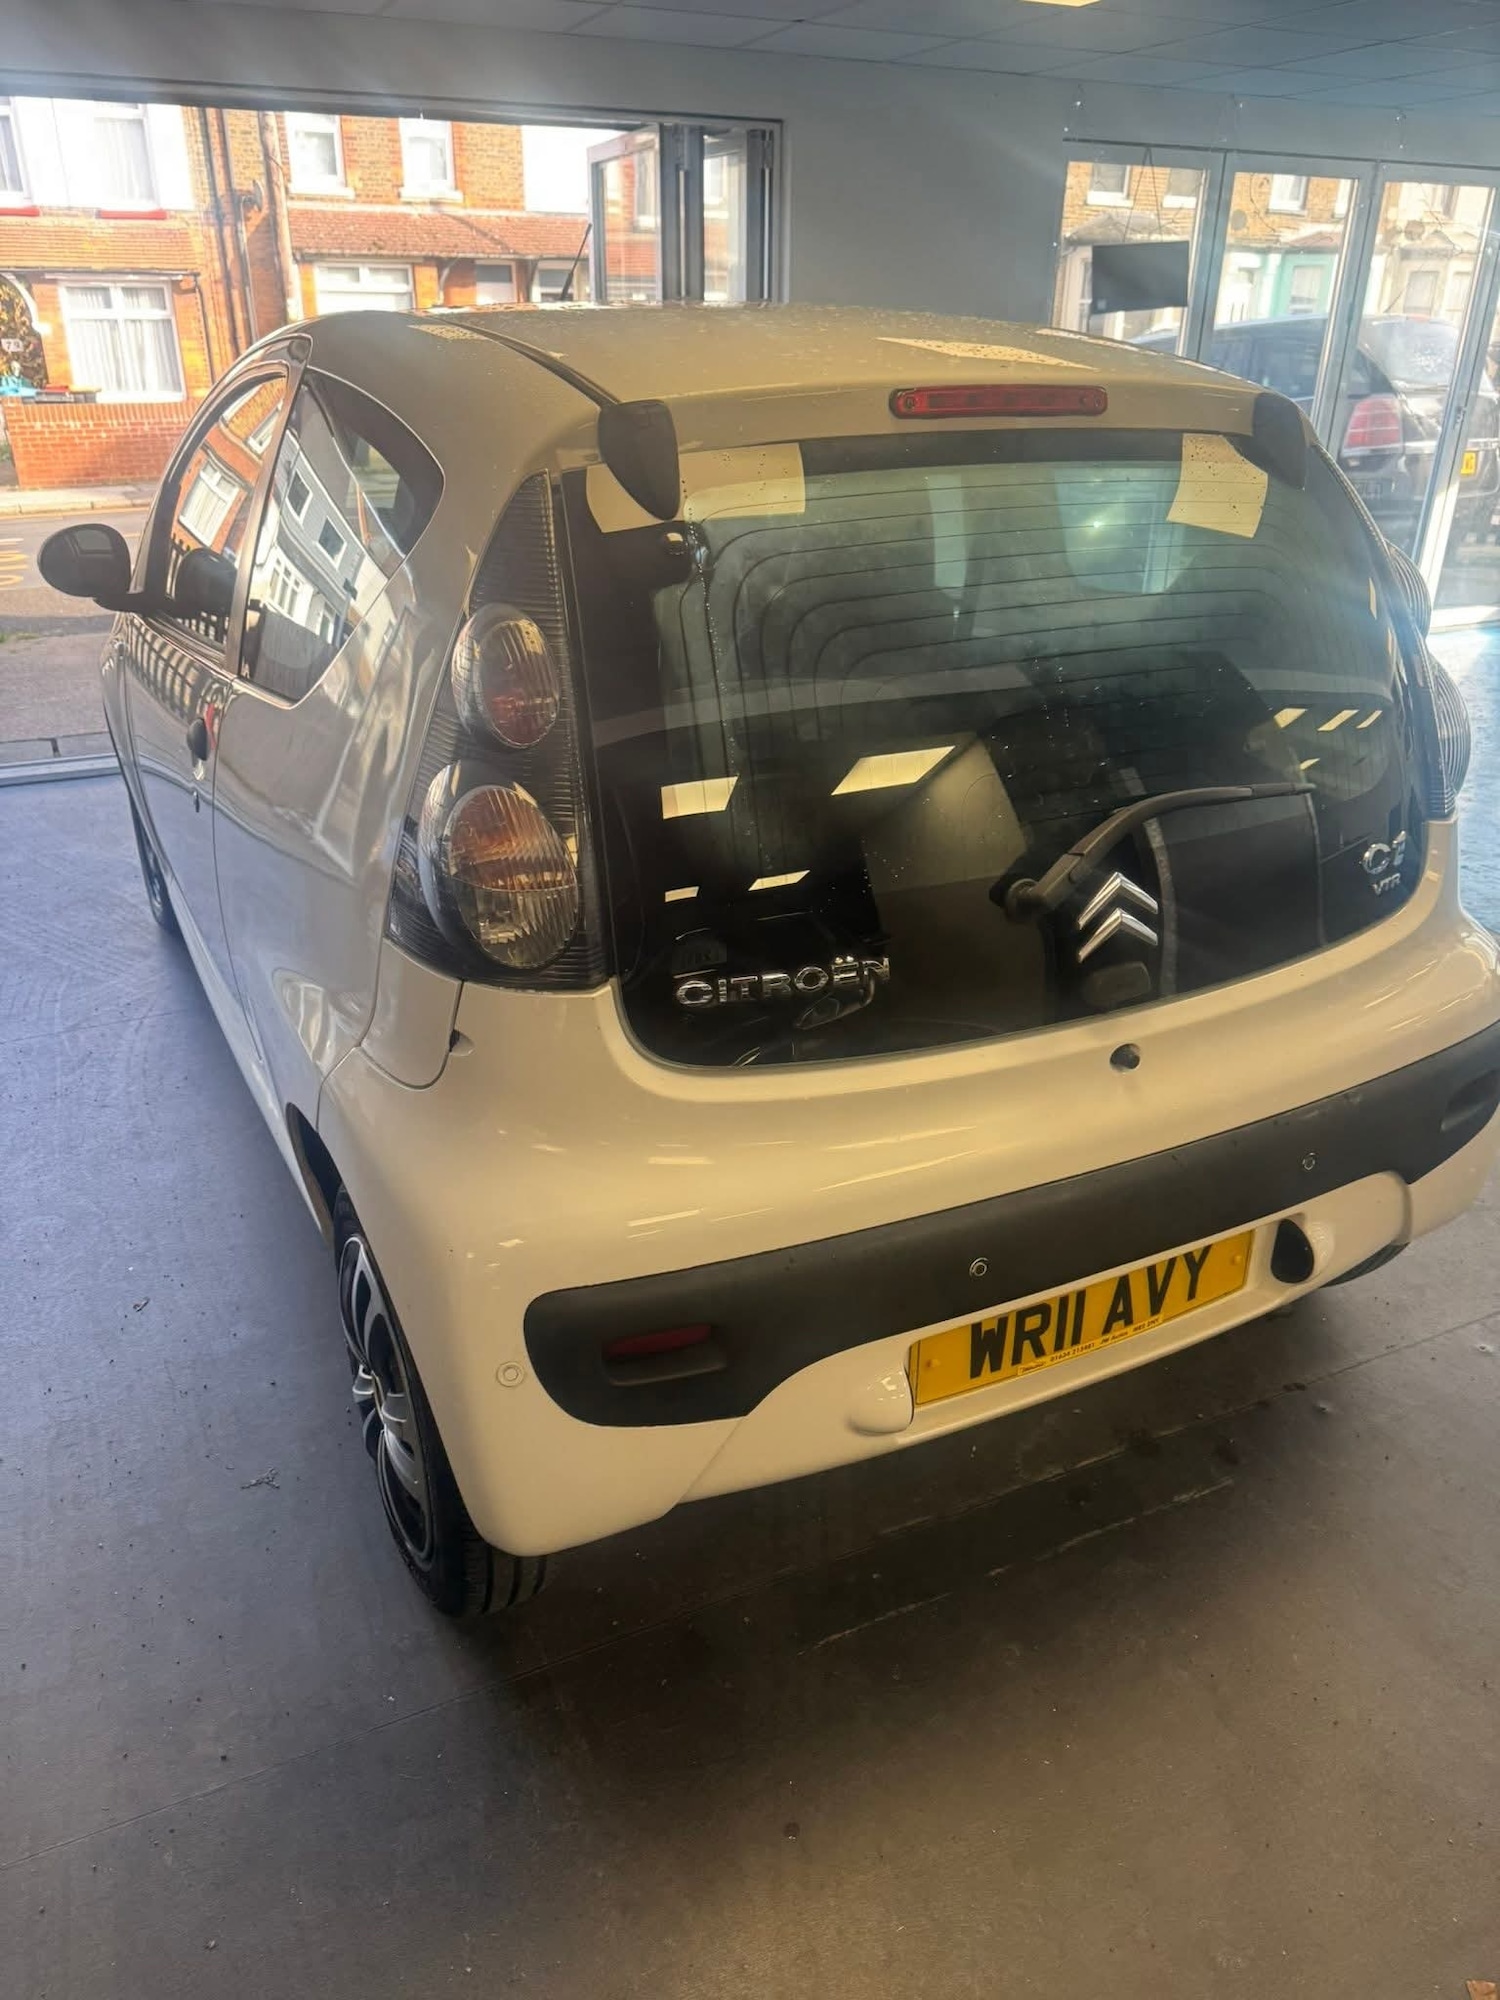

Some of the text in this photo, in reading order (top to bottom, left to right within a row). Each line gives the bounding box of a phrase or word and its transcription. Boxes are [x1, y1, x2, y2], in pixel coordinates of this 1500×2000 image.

[1372, 873, 1401, 895] VTR
[676, 955, 890, 1005] CITROËN
[970, 1244, 1213, 1379] WR11 AVY
